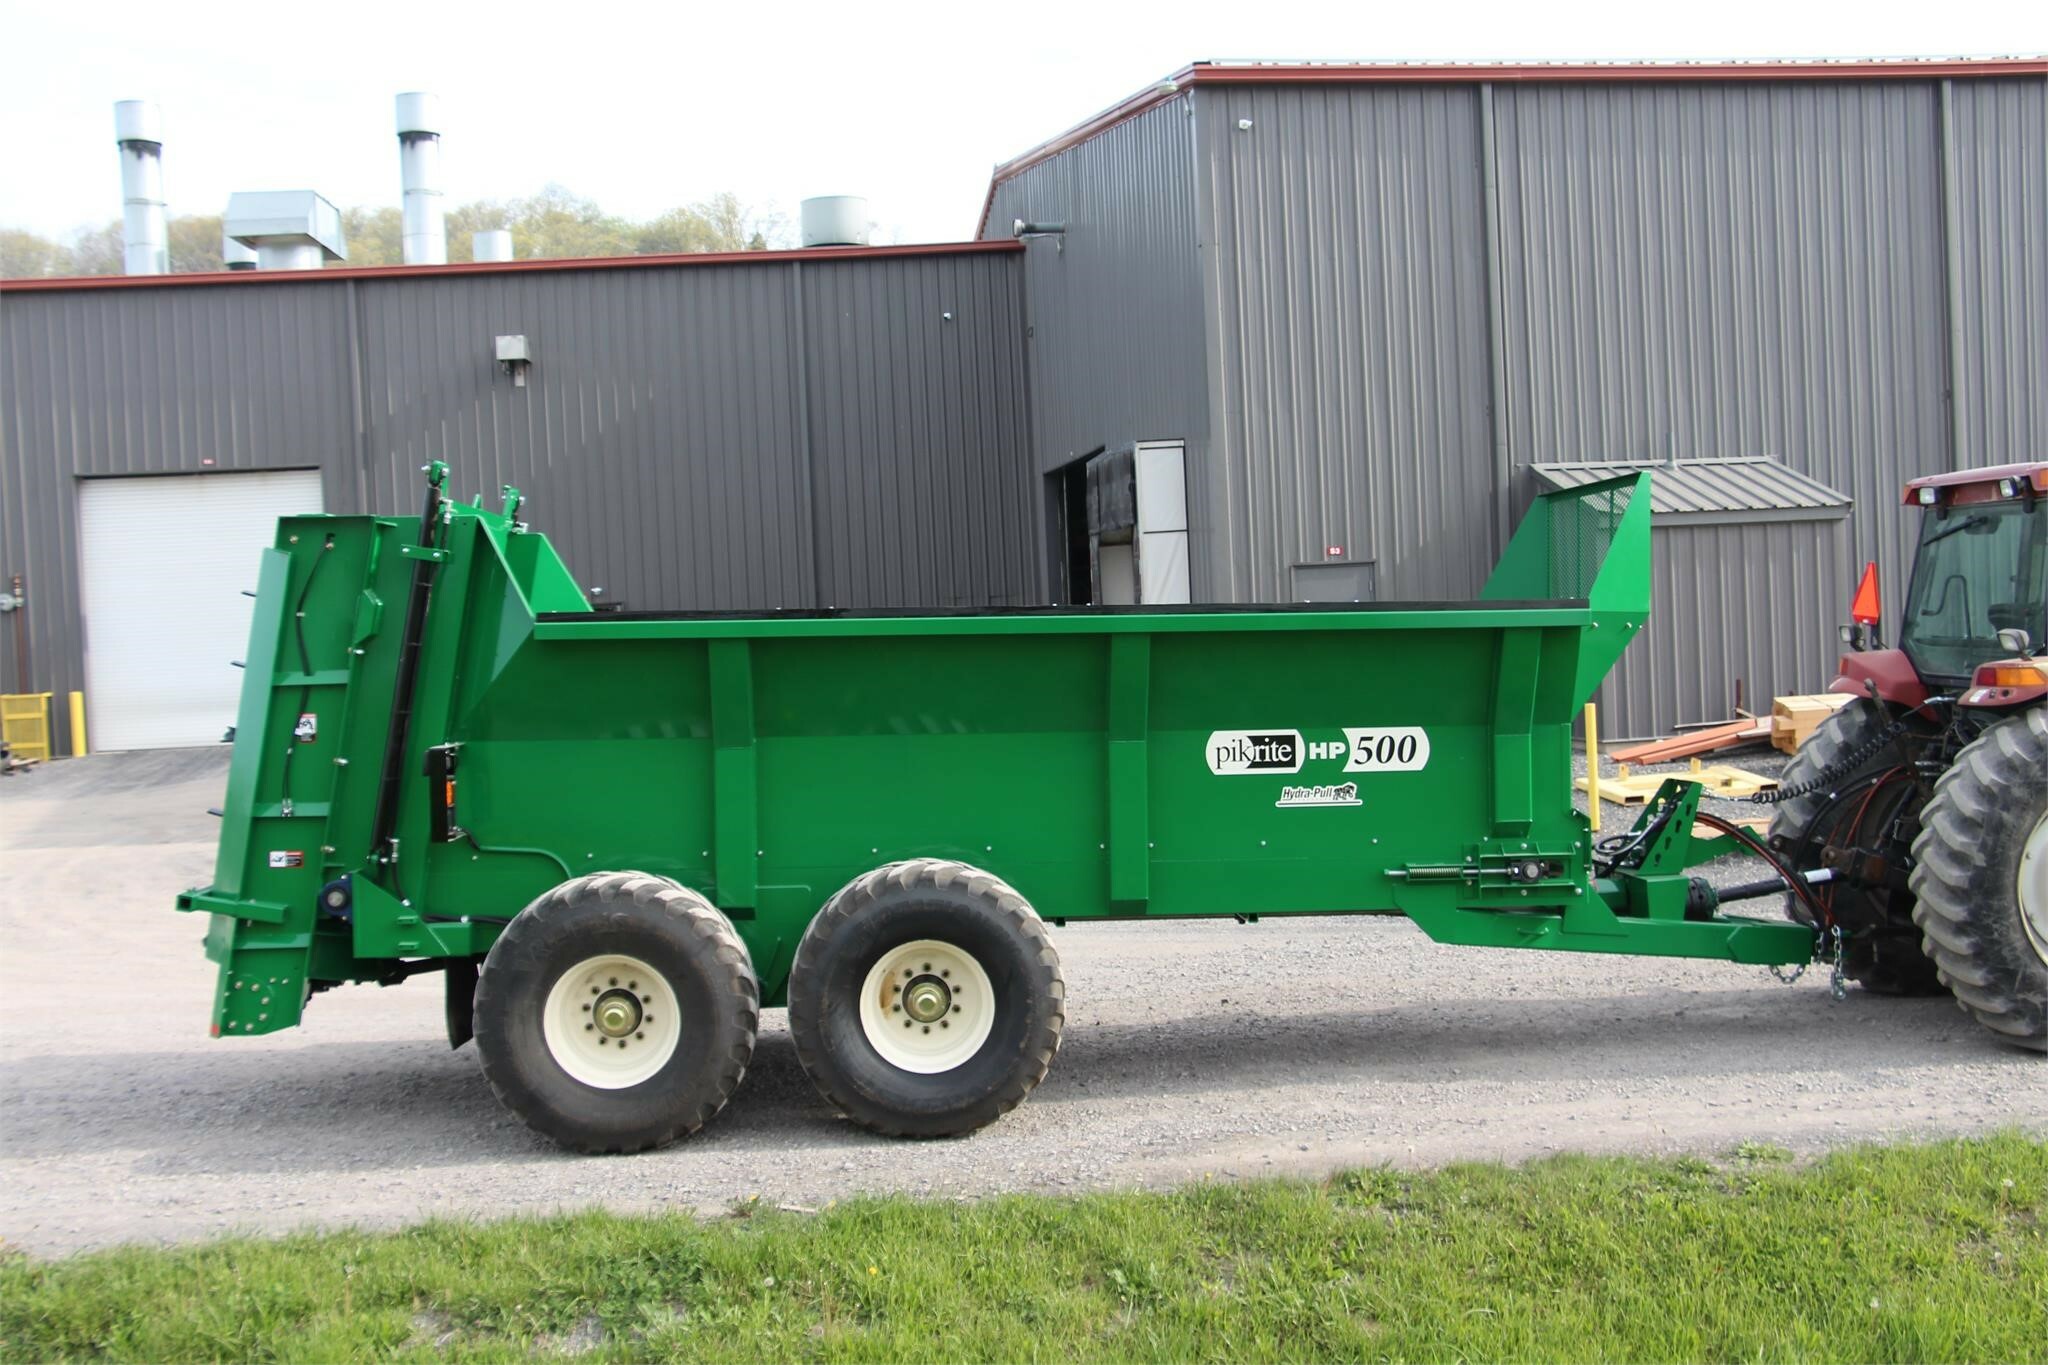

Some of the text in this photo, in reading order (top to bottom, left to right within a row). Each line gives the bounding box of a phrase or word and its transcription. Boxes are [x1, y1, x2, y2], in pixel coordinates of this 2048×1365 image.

[1309, 742, 1346, 759] HP
[1354, 735, 1417, 765] 500
[1283, 787, 1333, 800] Hydra-Pull
